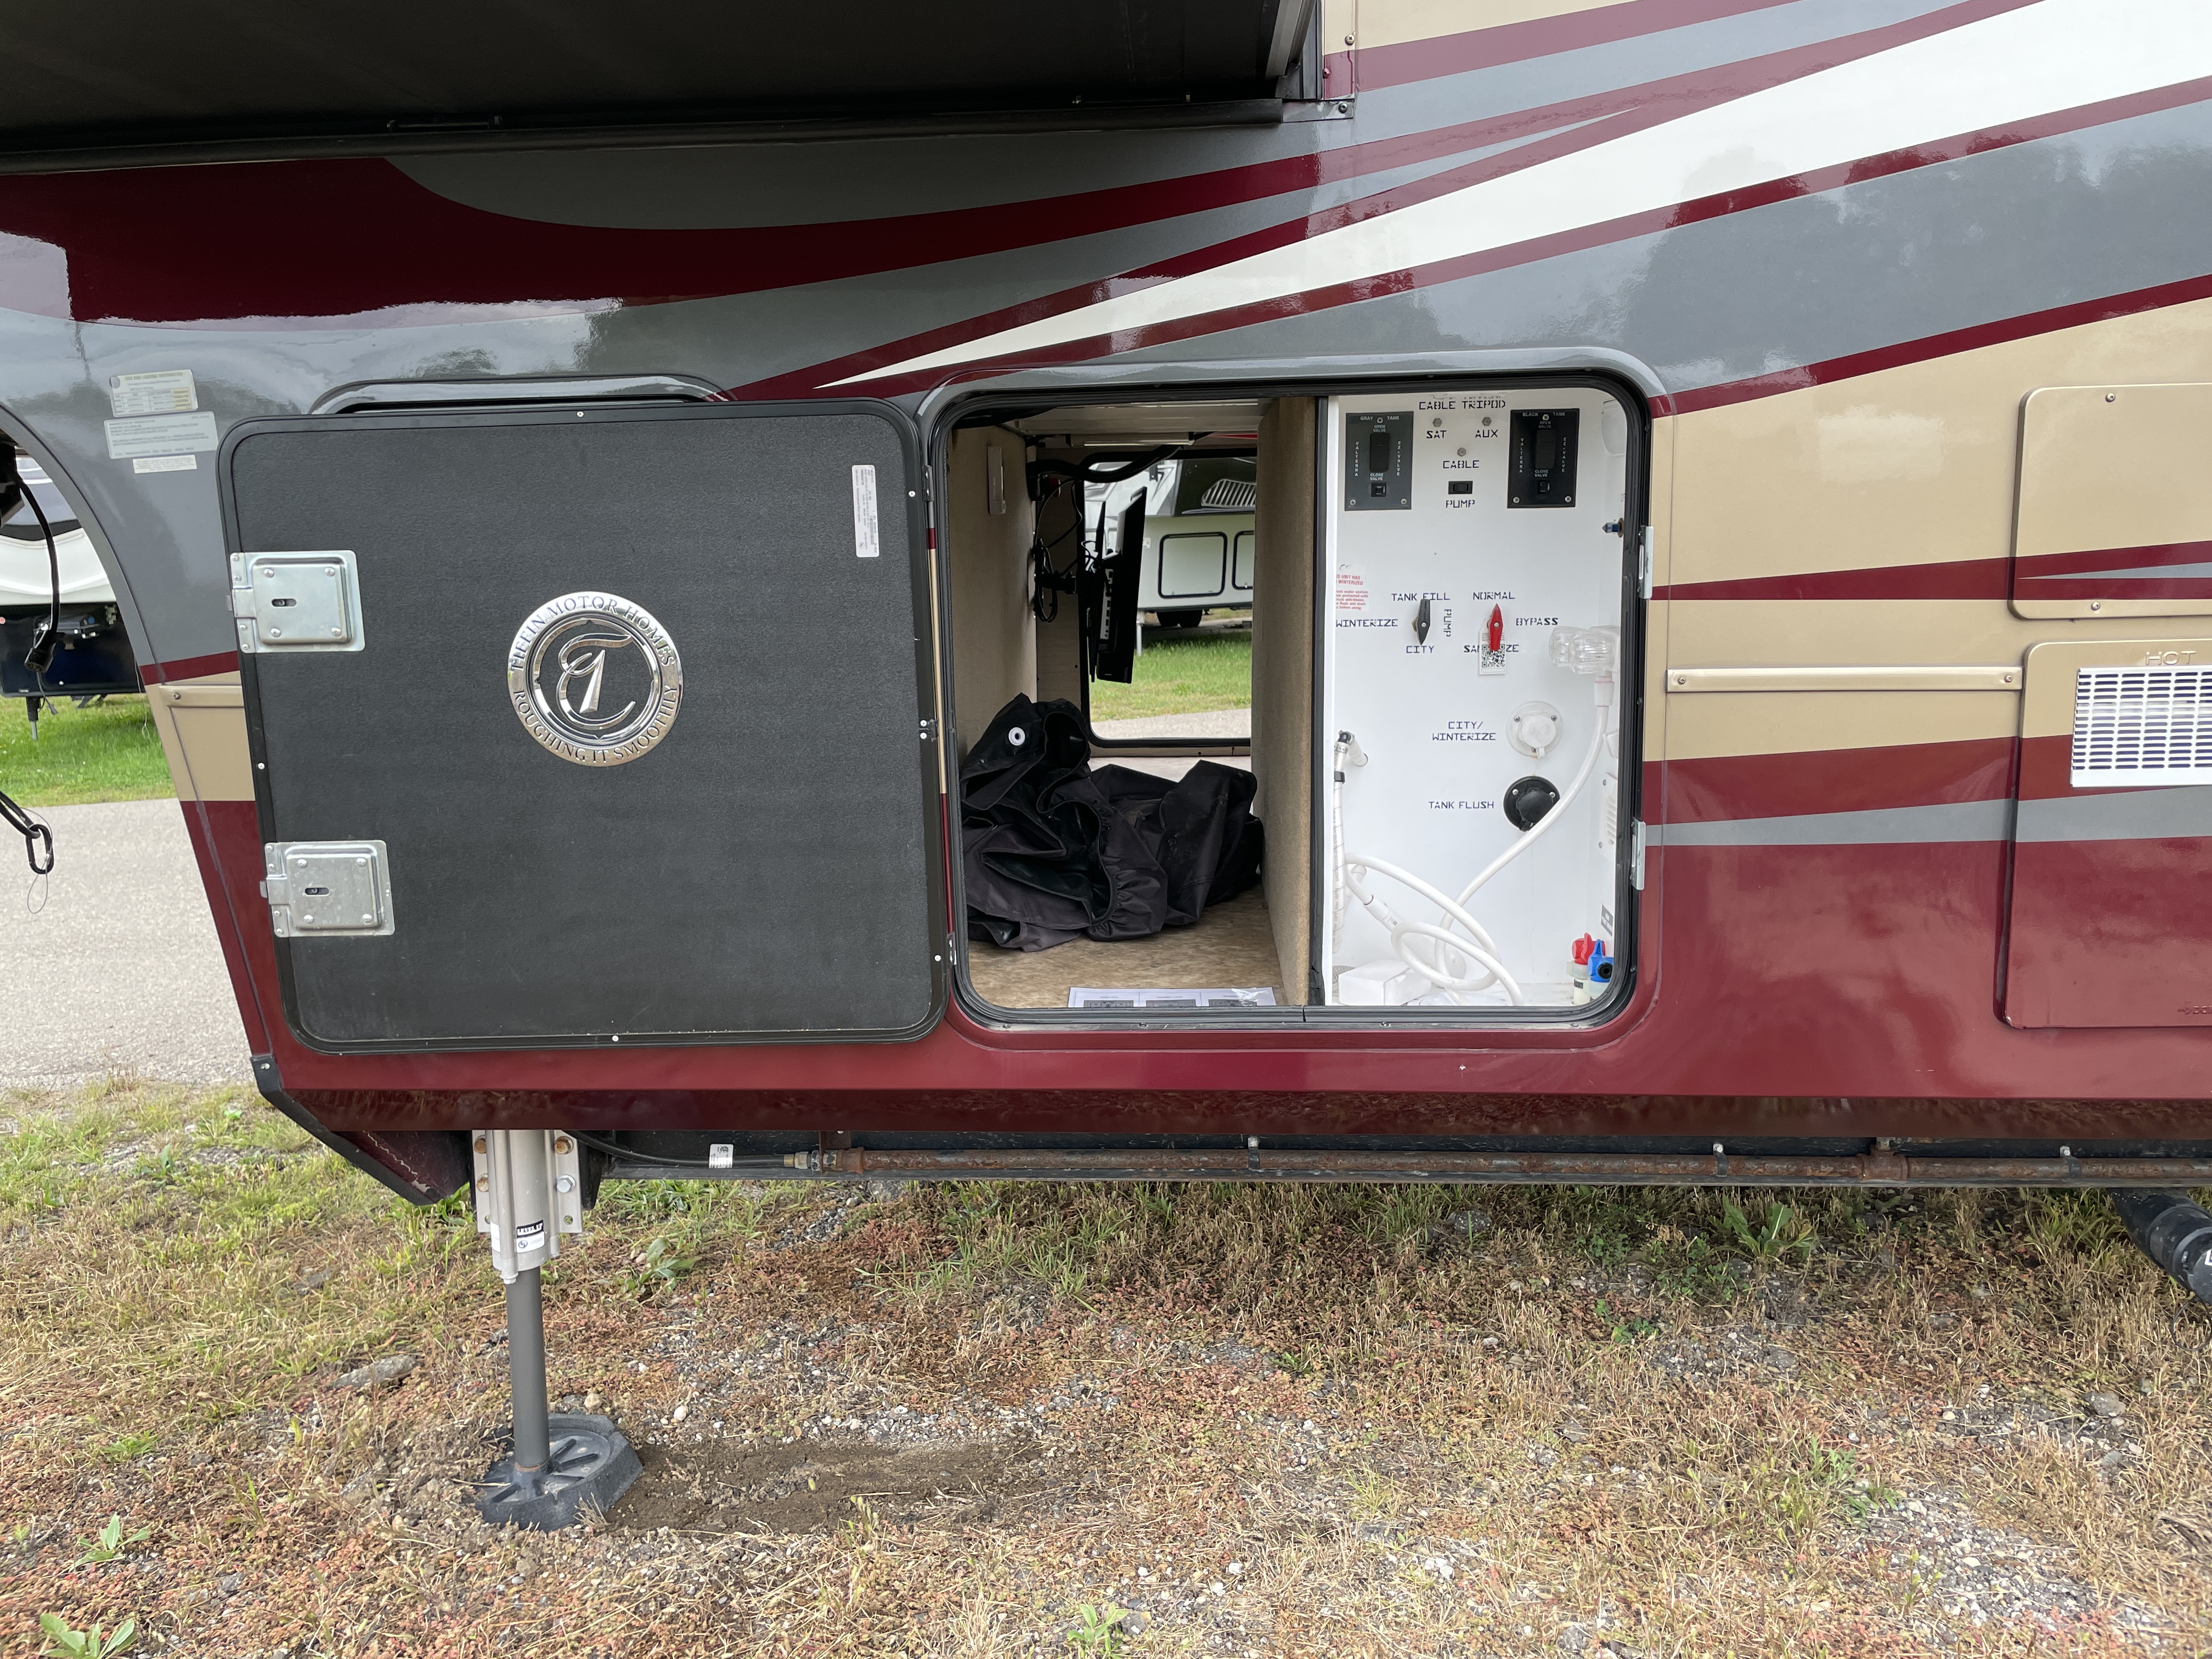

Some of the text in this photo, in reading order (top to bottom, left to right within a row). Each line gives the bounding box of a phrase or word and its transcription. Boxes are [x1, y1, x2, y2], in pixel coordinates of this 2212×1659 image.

[1419, 400, 1506, 410] CABLE TRIPOD
[1426, 430, 1447, 438] SAT
[1475, 430, 1498, 438] AUX
[1443, 460, 1479, 469] CABLE
[1446, 500, 1475, 508] PUMP
[1391, 592, 1451, 601] TANK FILL
[1472, 591, 1515, 600] NORMAL
[1336, 619, 1398, 627] WINTERIZE
[1443, 609, 1452, 637] PUMP
[1516, 618, 1559, 626] BYPASS
[511, 595, 676, 674] TIFFIN MOTOR HOMES
[1464, 644, 1520, 653] SAZE
[2145, 651, 2197, 665] HOT
[513, 684, 678, 763] ROUGHING IT SMOOTHLY
[1448, 721, 1483, 730] CITY/
[1432, 732, 1497, 741] WINTERIZE
[1428, 801, 1494, 809] TANK FLUSH
